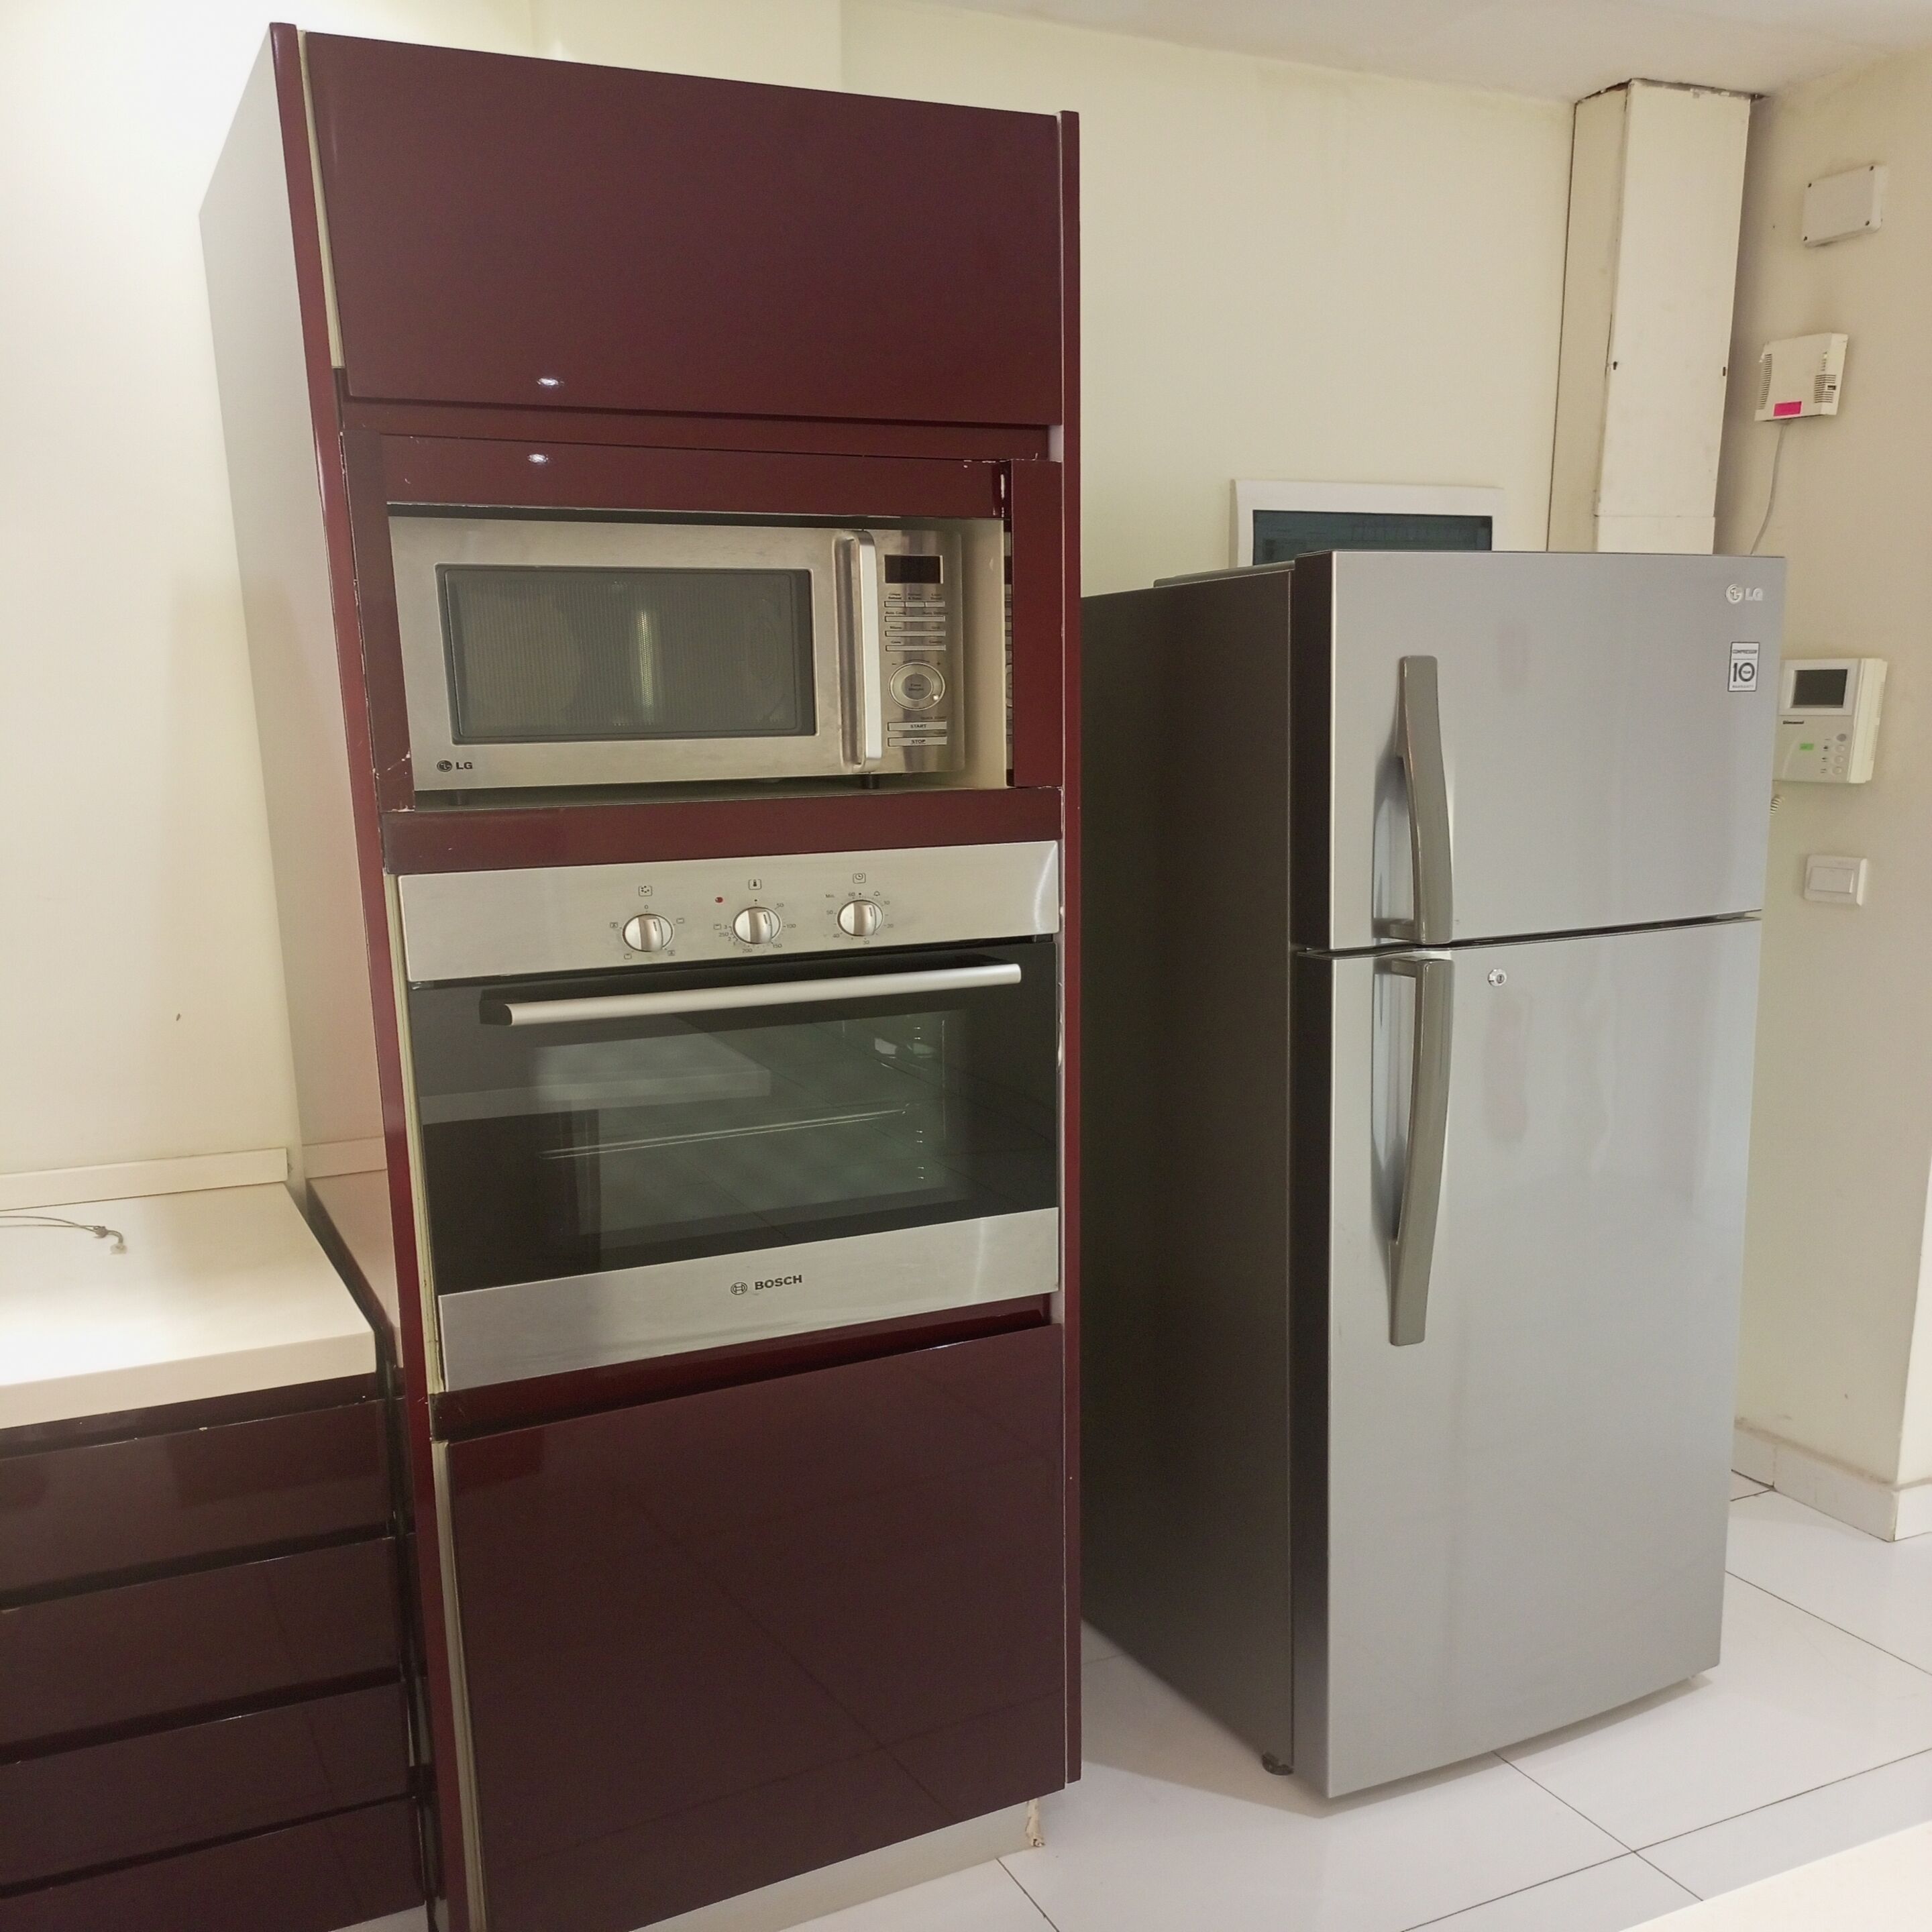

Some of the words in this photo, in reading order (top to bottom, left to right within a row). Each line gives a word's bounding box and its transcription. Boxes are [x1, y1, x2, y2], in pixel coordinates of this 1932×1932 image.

[1745, 588, 1764, 601] LG
[1733, 662, 1755, 682] 10
[455, 761, 473, 770] LG
[755, 1275, 802, 1290] BOSCH
